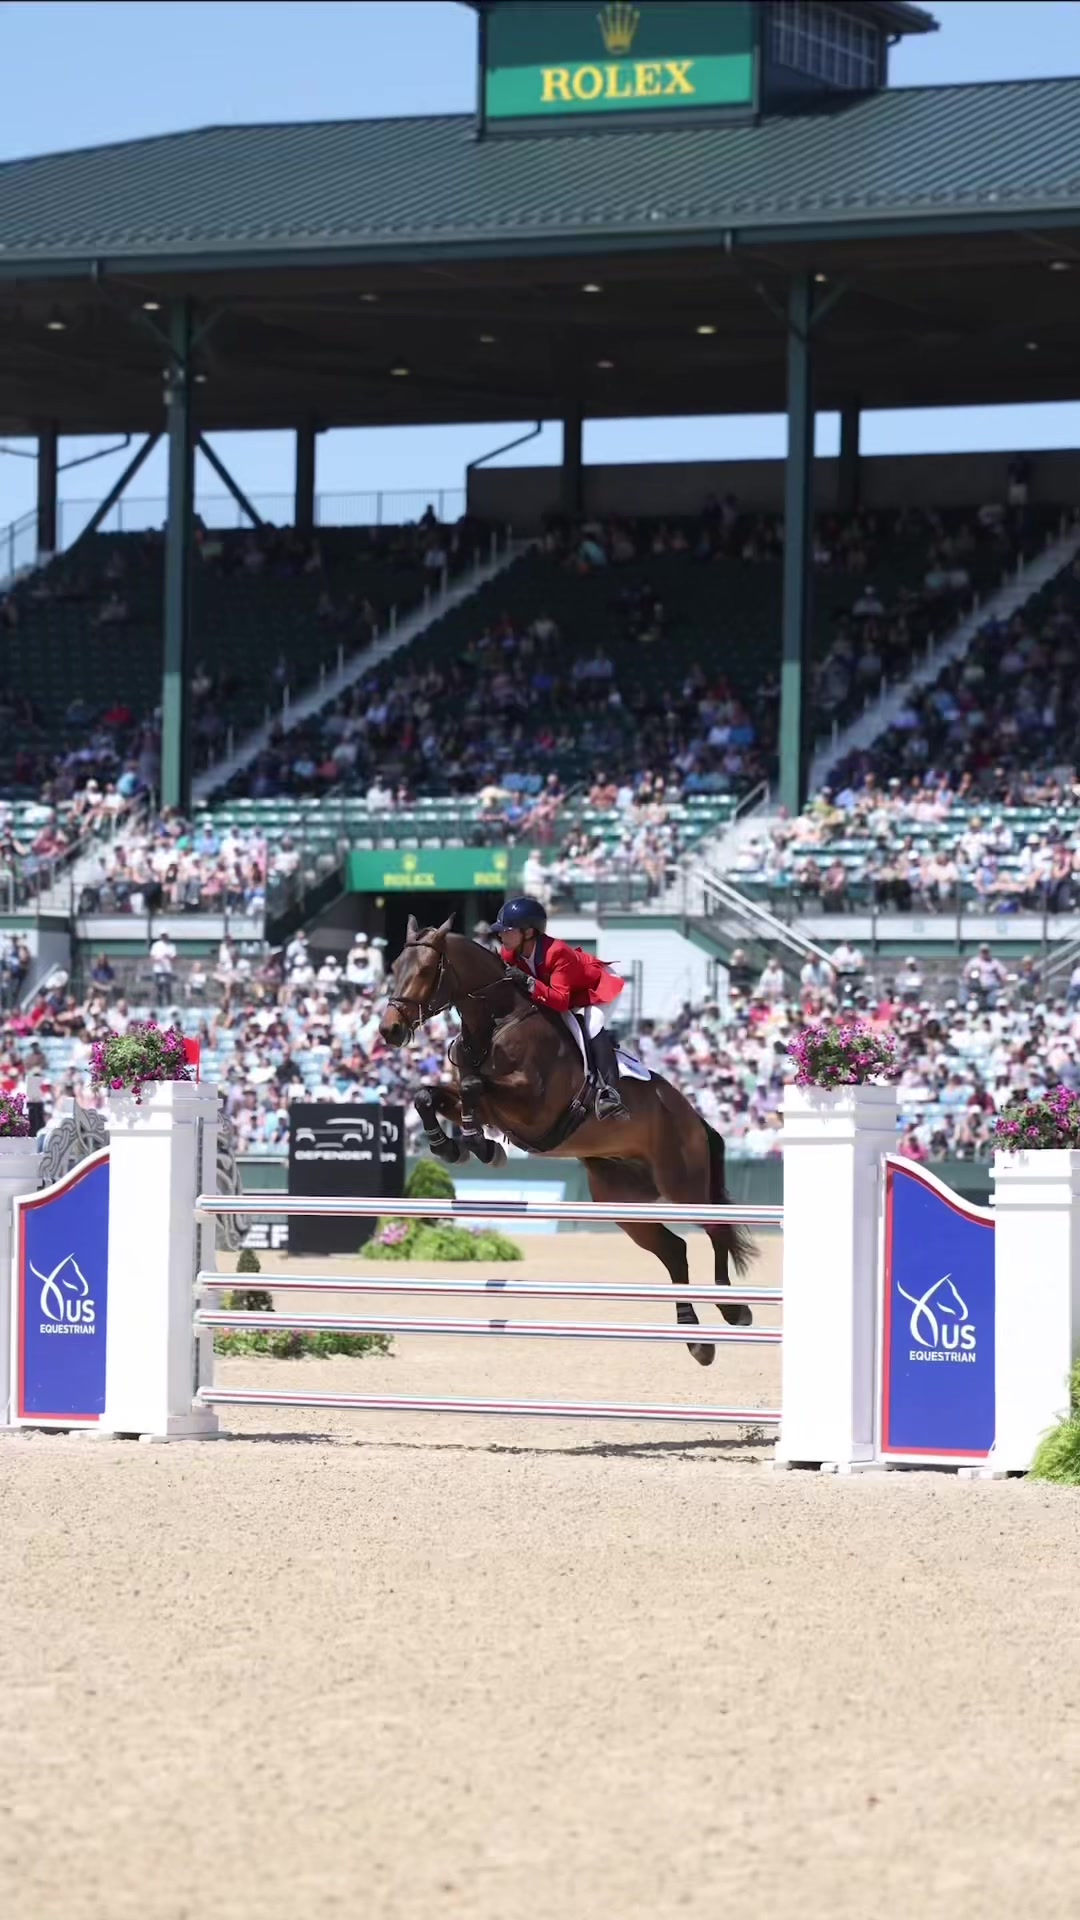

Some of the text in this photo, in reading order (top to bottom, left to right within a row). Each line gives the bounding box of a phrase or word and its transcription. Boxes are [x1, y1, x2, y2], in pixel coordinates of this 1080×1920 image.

[540, 60, 695, 102] ROLEX
[294, 1150, 373, 1161] DEFENDER
[66, 1299, 95, 1323] US
[40, 1323, 95, 1335] EQUESTRIAN
[941, 1323, 977, 1350] US
[909, 1350, 977, 1363] EQUESTRIAN
